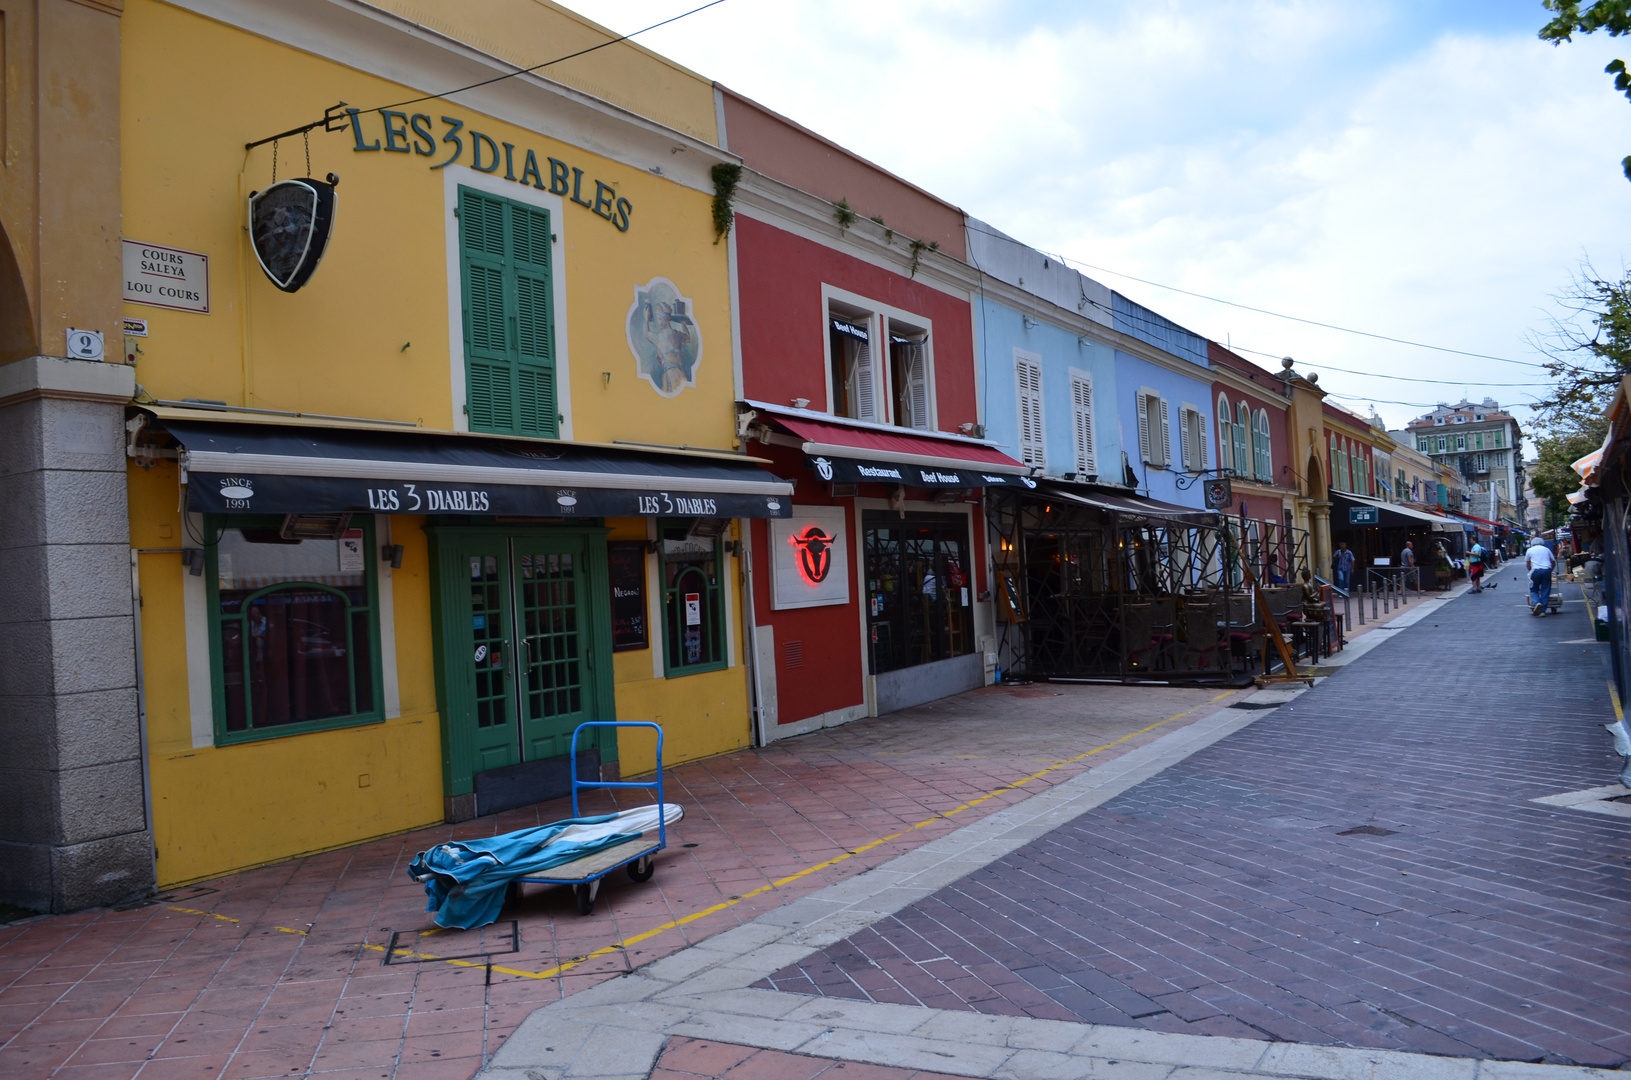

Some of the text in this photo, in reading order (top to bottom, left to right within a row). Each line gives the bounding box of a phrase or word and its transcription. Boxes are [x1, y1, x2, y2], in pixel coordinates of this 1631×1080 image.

[346, 108, 633, 233] LES 3 DIABLES
[142, 249, 183, 265] COURS
[141, 261, 185, 277] SALEYA
[127, 281, 200, 301] LOU COURS
[80, 335, 93, 355] 2
[857, 465, 960, 484] Restaurant Beef House
[220, 478, 253, 489] SINCE
[367, 484, 489, 512] LES 3 DIABLES
[557, 490, 577, 498] SINCE
[225, 499, 251, 509] 1991
[560, 506, 575, 514] 1991
[639, 492, 717, 515] LES 3 DIABLES
